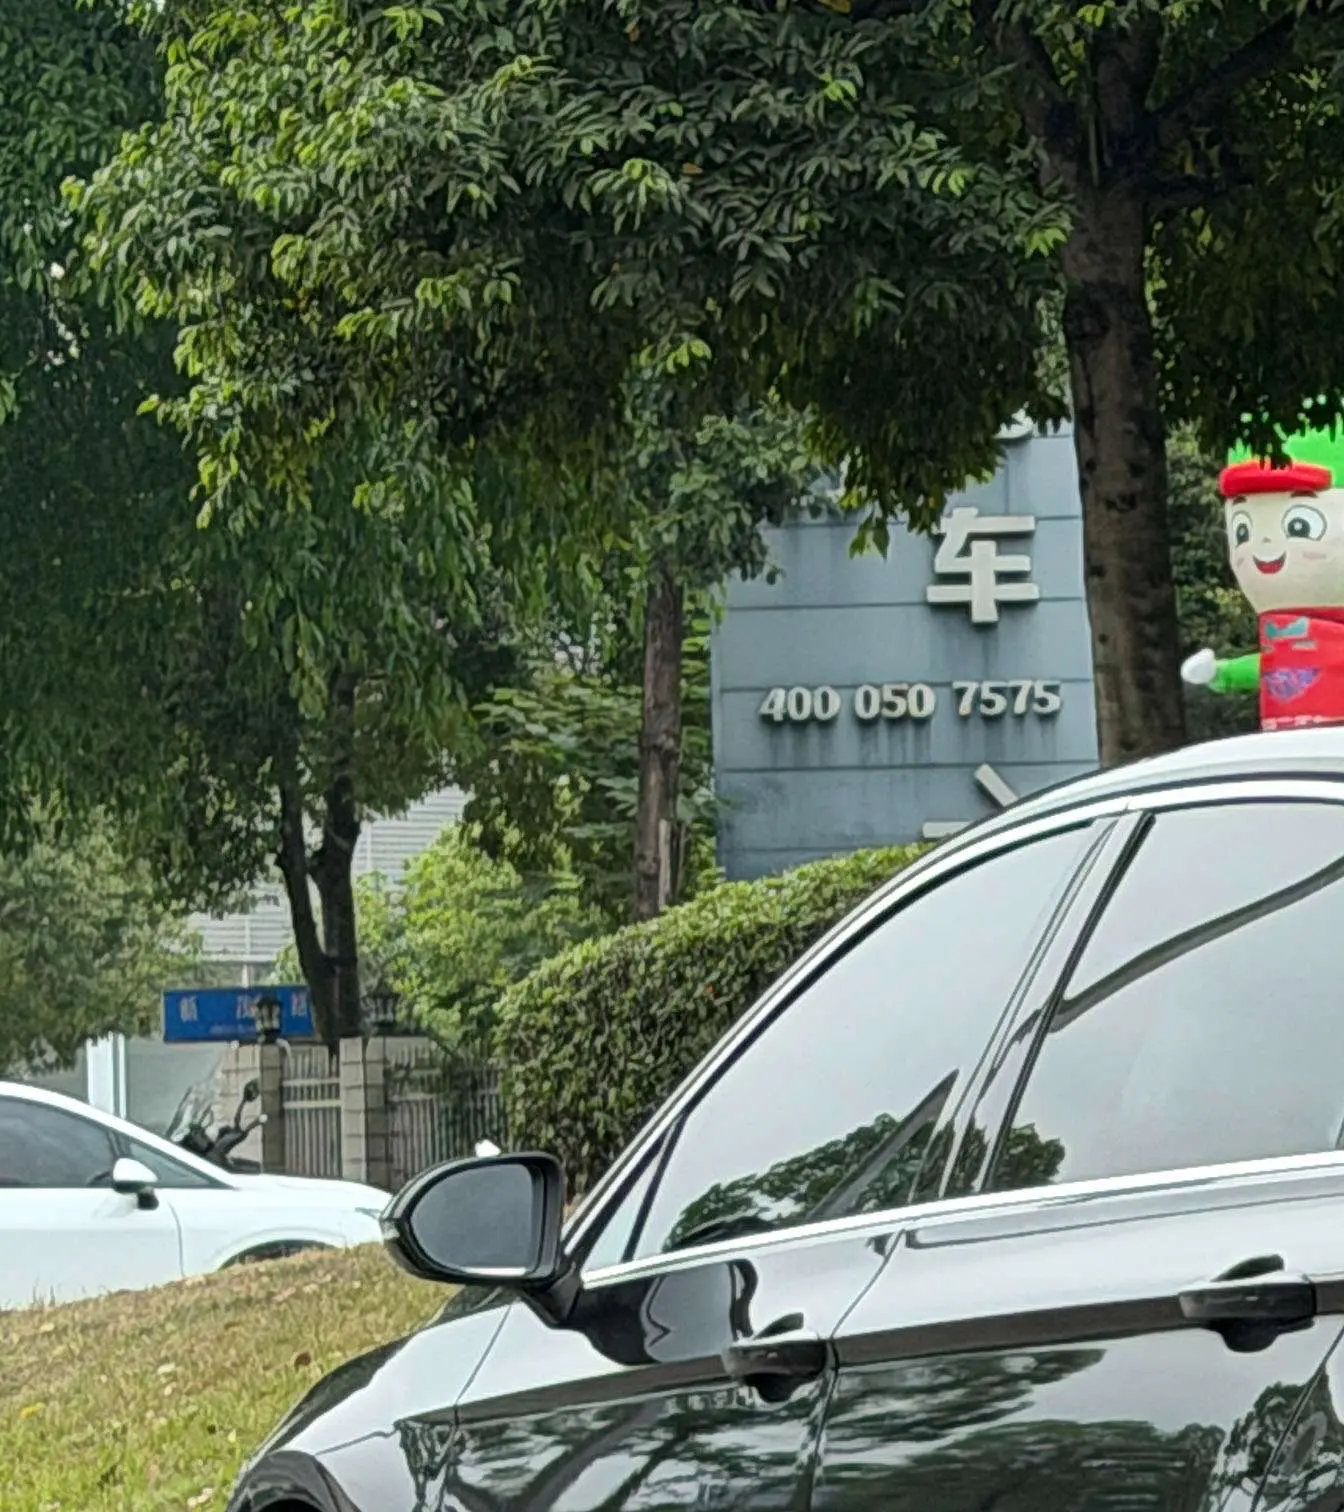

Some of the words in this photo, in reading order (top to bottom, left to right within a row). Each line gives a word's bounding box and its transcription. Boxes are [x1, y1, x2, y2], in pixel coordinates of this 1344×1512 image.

[926, 506, 1040, 624] 车
[759, 685, 841, 723] 400
[854, 683, 935, 720] 050
[951, 679, 1061, 717] 7575
